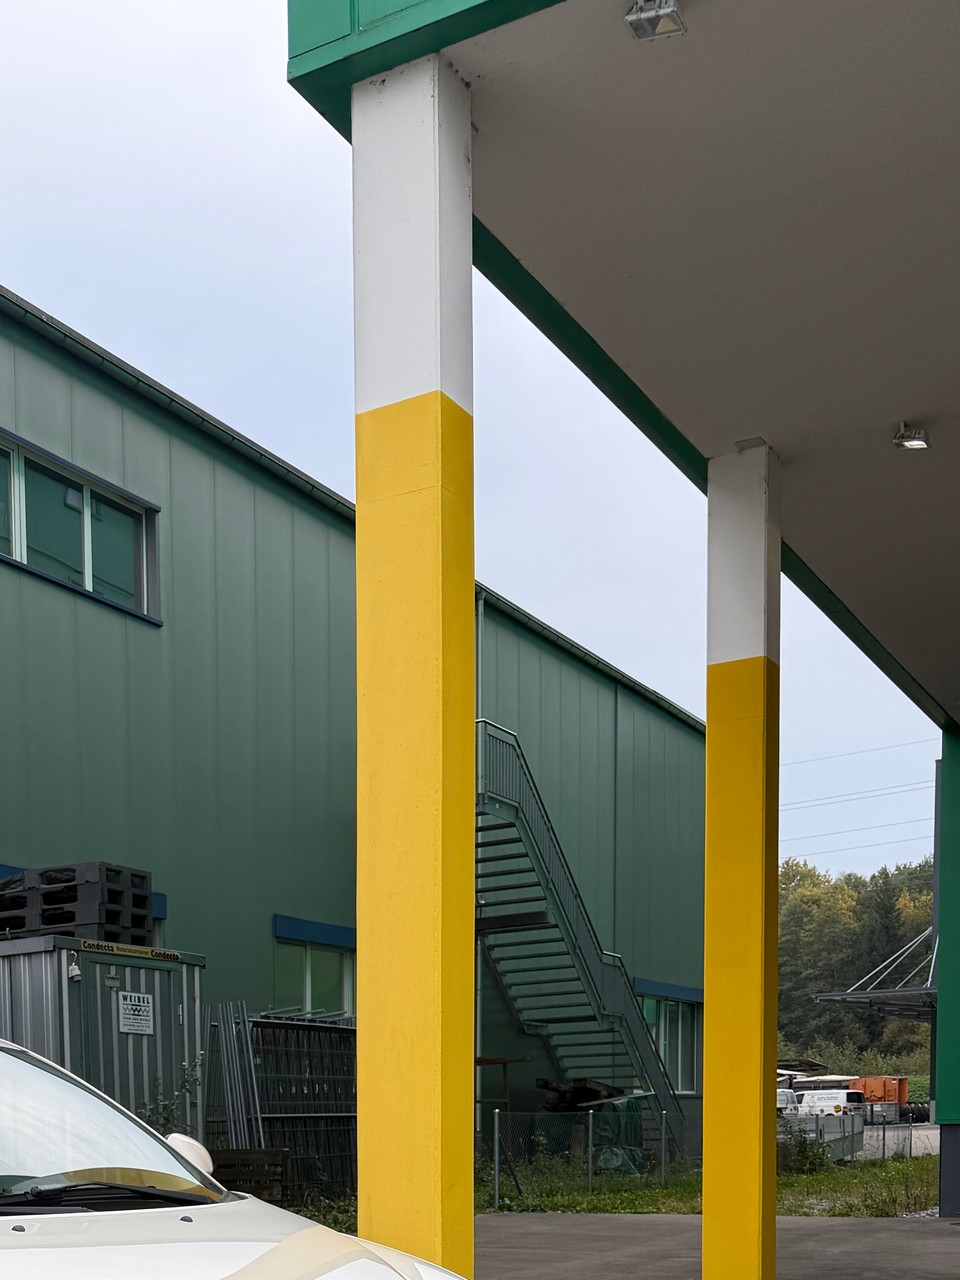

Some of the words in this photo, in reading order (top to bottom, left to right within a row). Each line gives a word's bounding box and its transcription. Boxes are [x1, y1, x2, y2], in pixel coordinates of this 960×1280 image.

[83, 941, 114, 952] Condecta
[150, 949, 180, 961] Condecta
[121, 994, 150, 1005] WEIBEL
